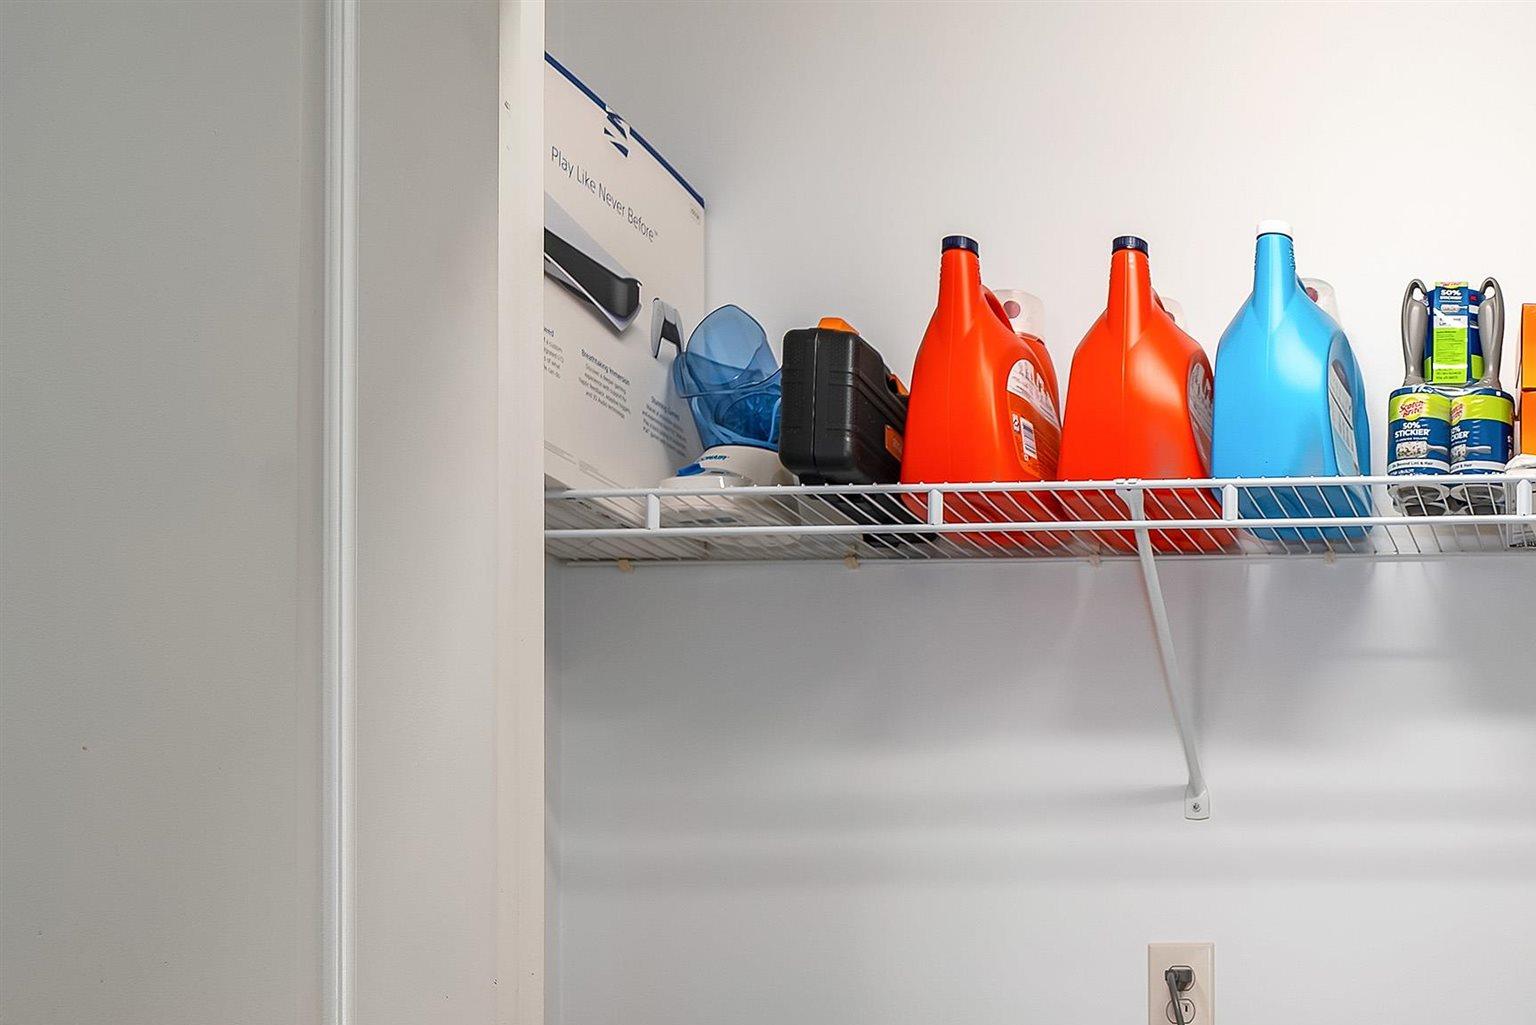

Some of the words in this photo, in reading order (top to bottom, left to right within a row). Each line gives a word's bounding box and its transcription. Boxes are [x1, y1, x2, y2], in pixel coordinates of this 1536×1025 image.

[551, 146, 575, 178] Play
[576, 165, 596, 194] Like
[599, 183, 626, 217] Never
[1402, 421, 1420, 430] 50%
[1395, 429, 1430, 438] STICKIER
